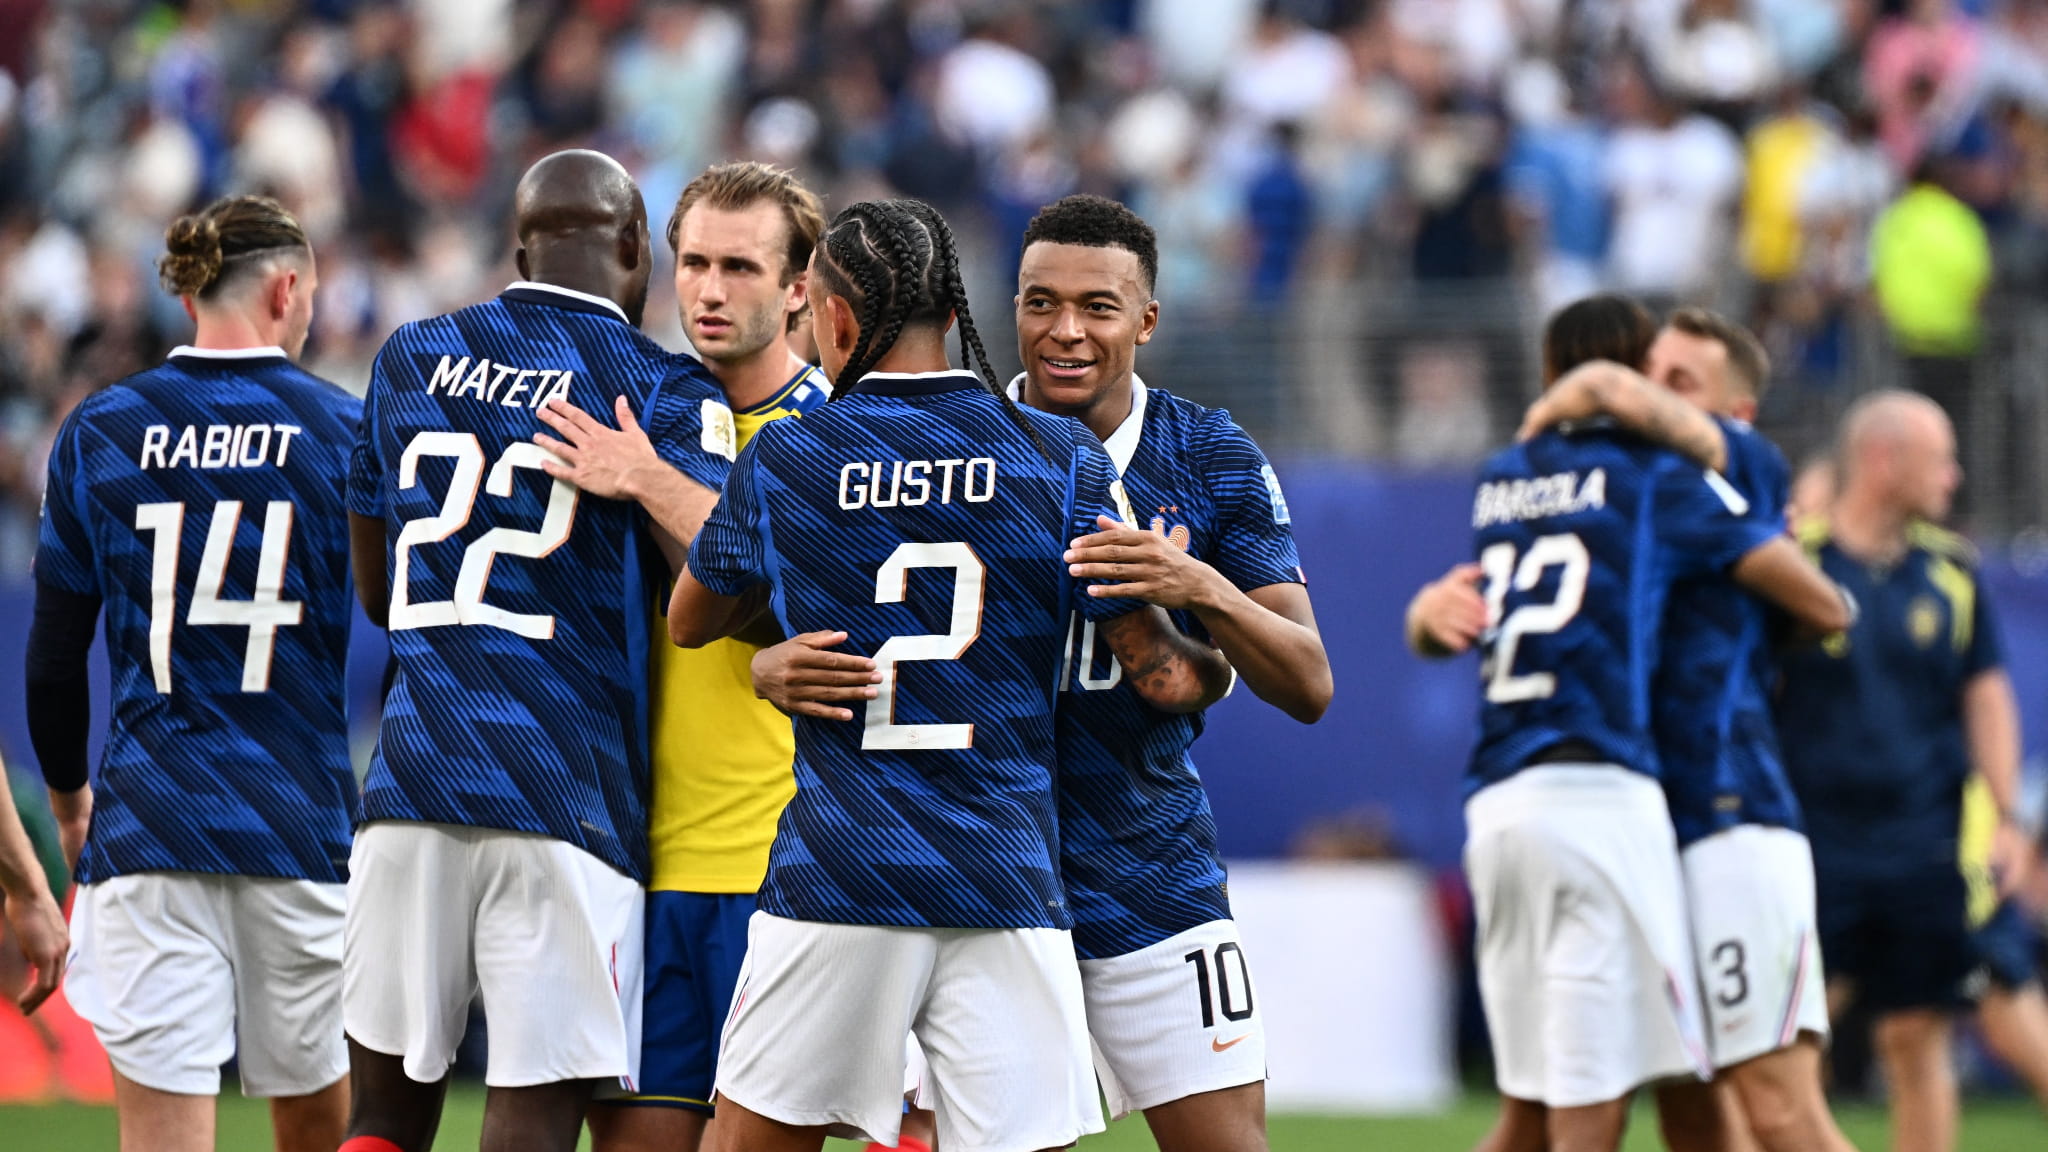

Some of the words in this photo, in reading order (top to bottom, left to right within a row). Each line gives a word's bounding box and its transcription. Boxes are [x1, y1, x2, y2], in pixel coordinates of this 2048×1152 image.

[426, 355, 573, 409] MATETA
[140, 424, 301, 471] RABIOT
[838, 457, 996, 511] GUSTO
[389, 431, 580, 640] 22
[135, 500, 304, 695] 14
[861, 541, 987, 751] 2
[1184, 941, 1254, 1029] 10
[1711, 938, 1749, 1006] 3
